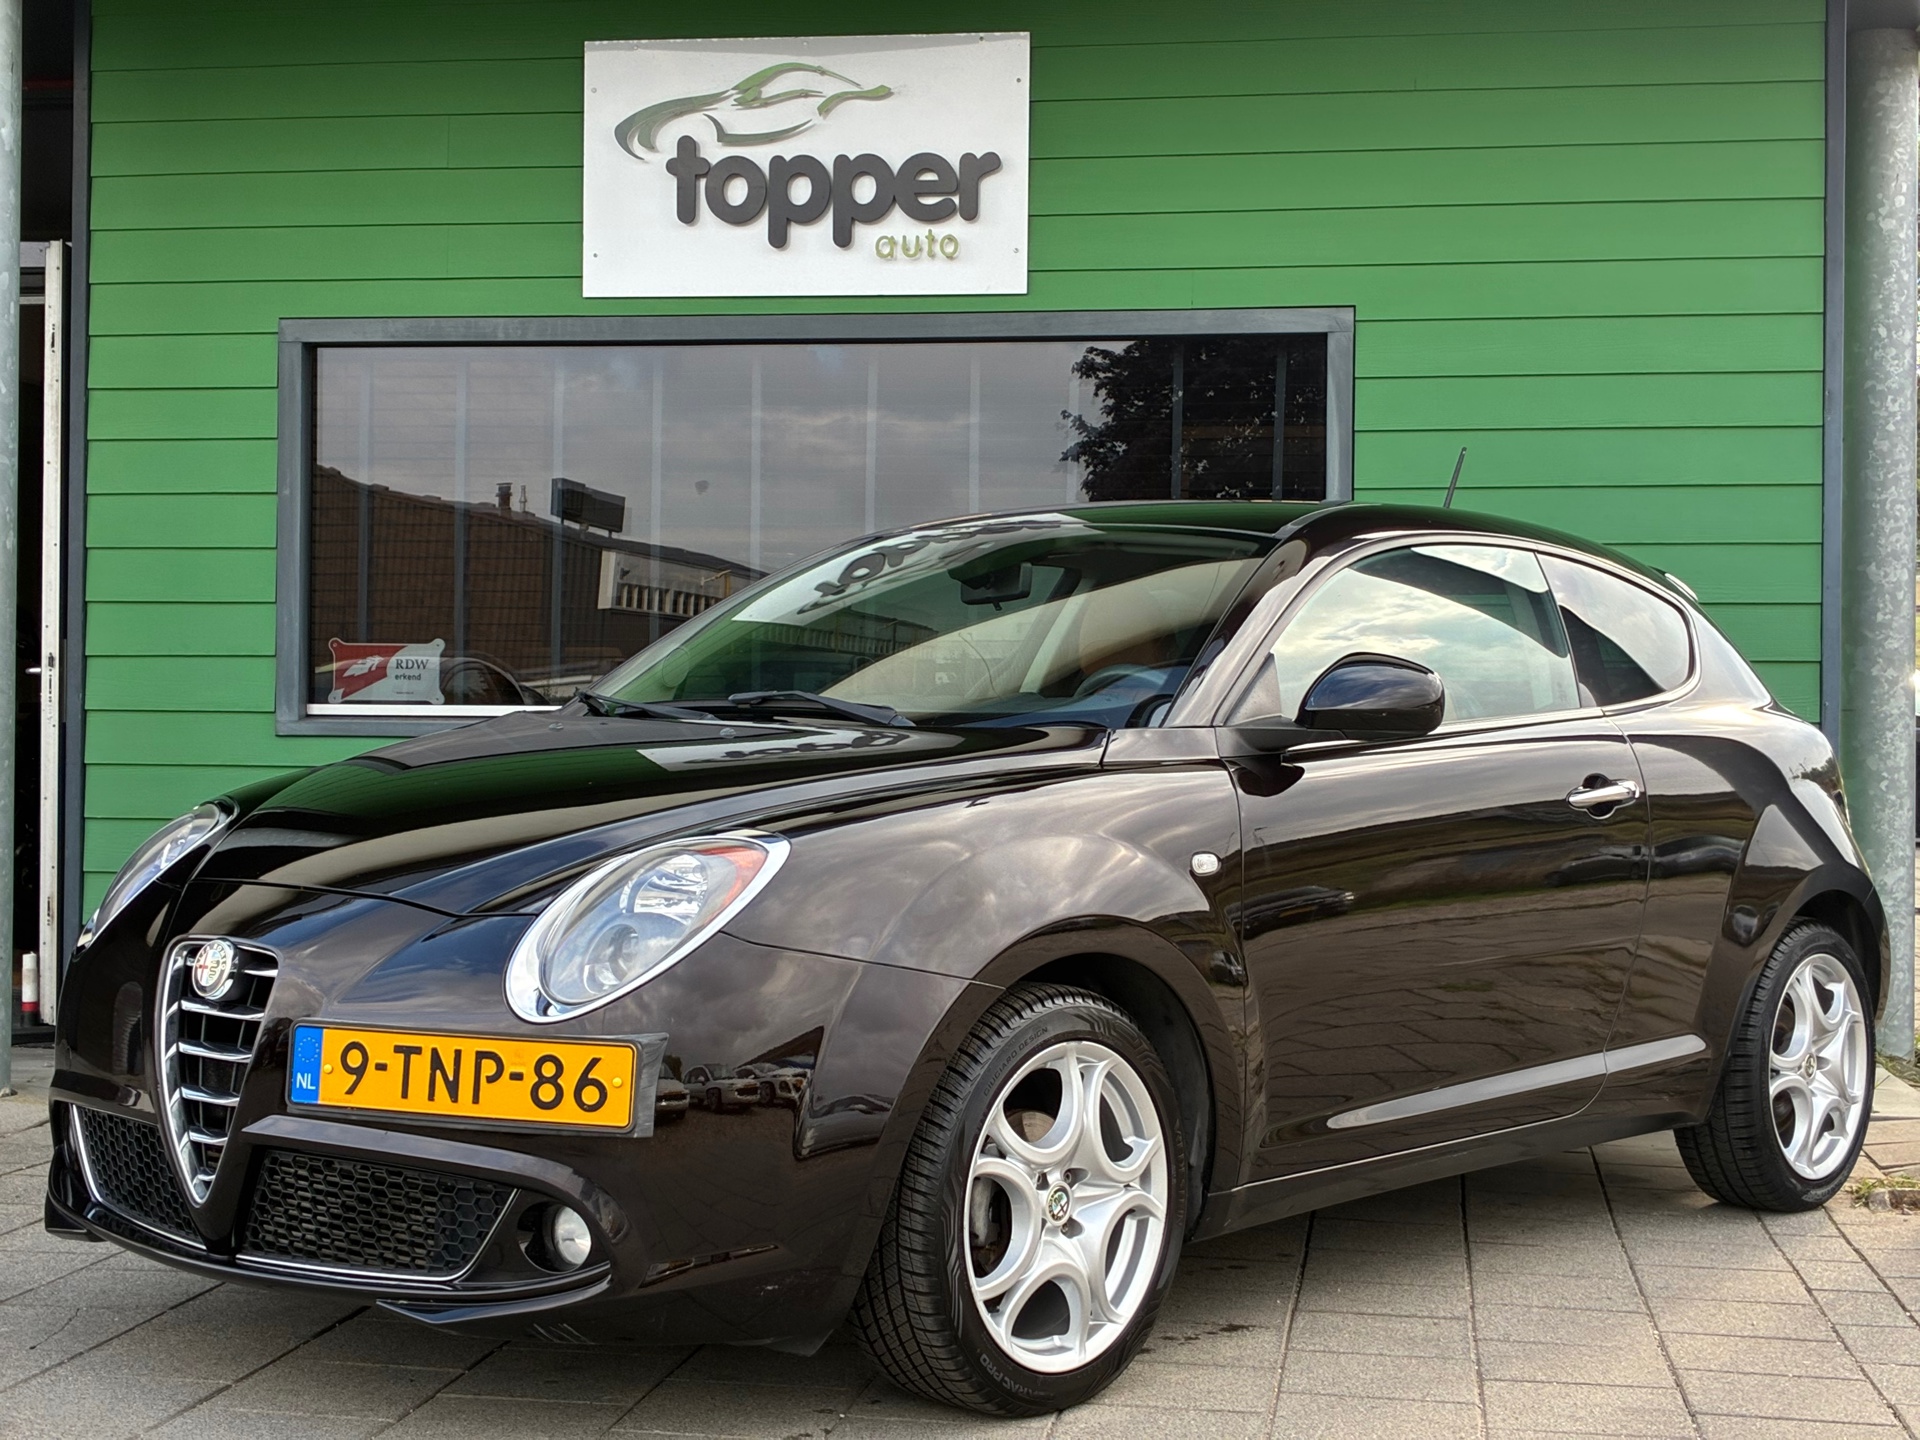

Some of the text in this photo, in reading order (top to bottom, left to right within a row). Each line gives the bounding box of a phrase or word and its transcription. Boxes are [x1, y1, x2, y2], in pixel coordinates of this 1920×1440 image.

[665, 134, 1003, 249] topper
[874, 228, 960, 260] auto
[394, 673, 422, 681] erkend
[395, 658, 430, 670] RDW
[1018, 1026, 1049, 1052] DESIGN
[295, 1072, 316, 1090] NL
[339, 1040, 608, 1113] 9-TNP-86
[980, 1352, 1004, 1382] PRO
